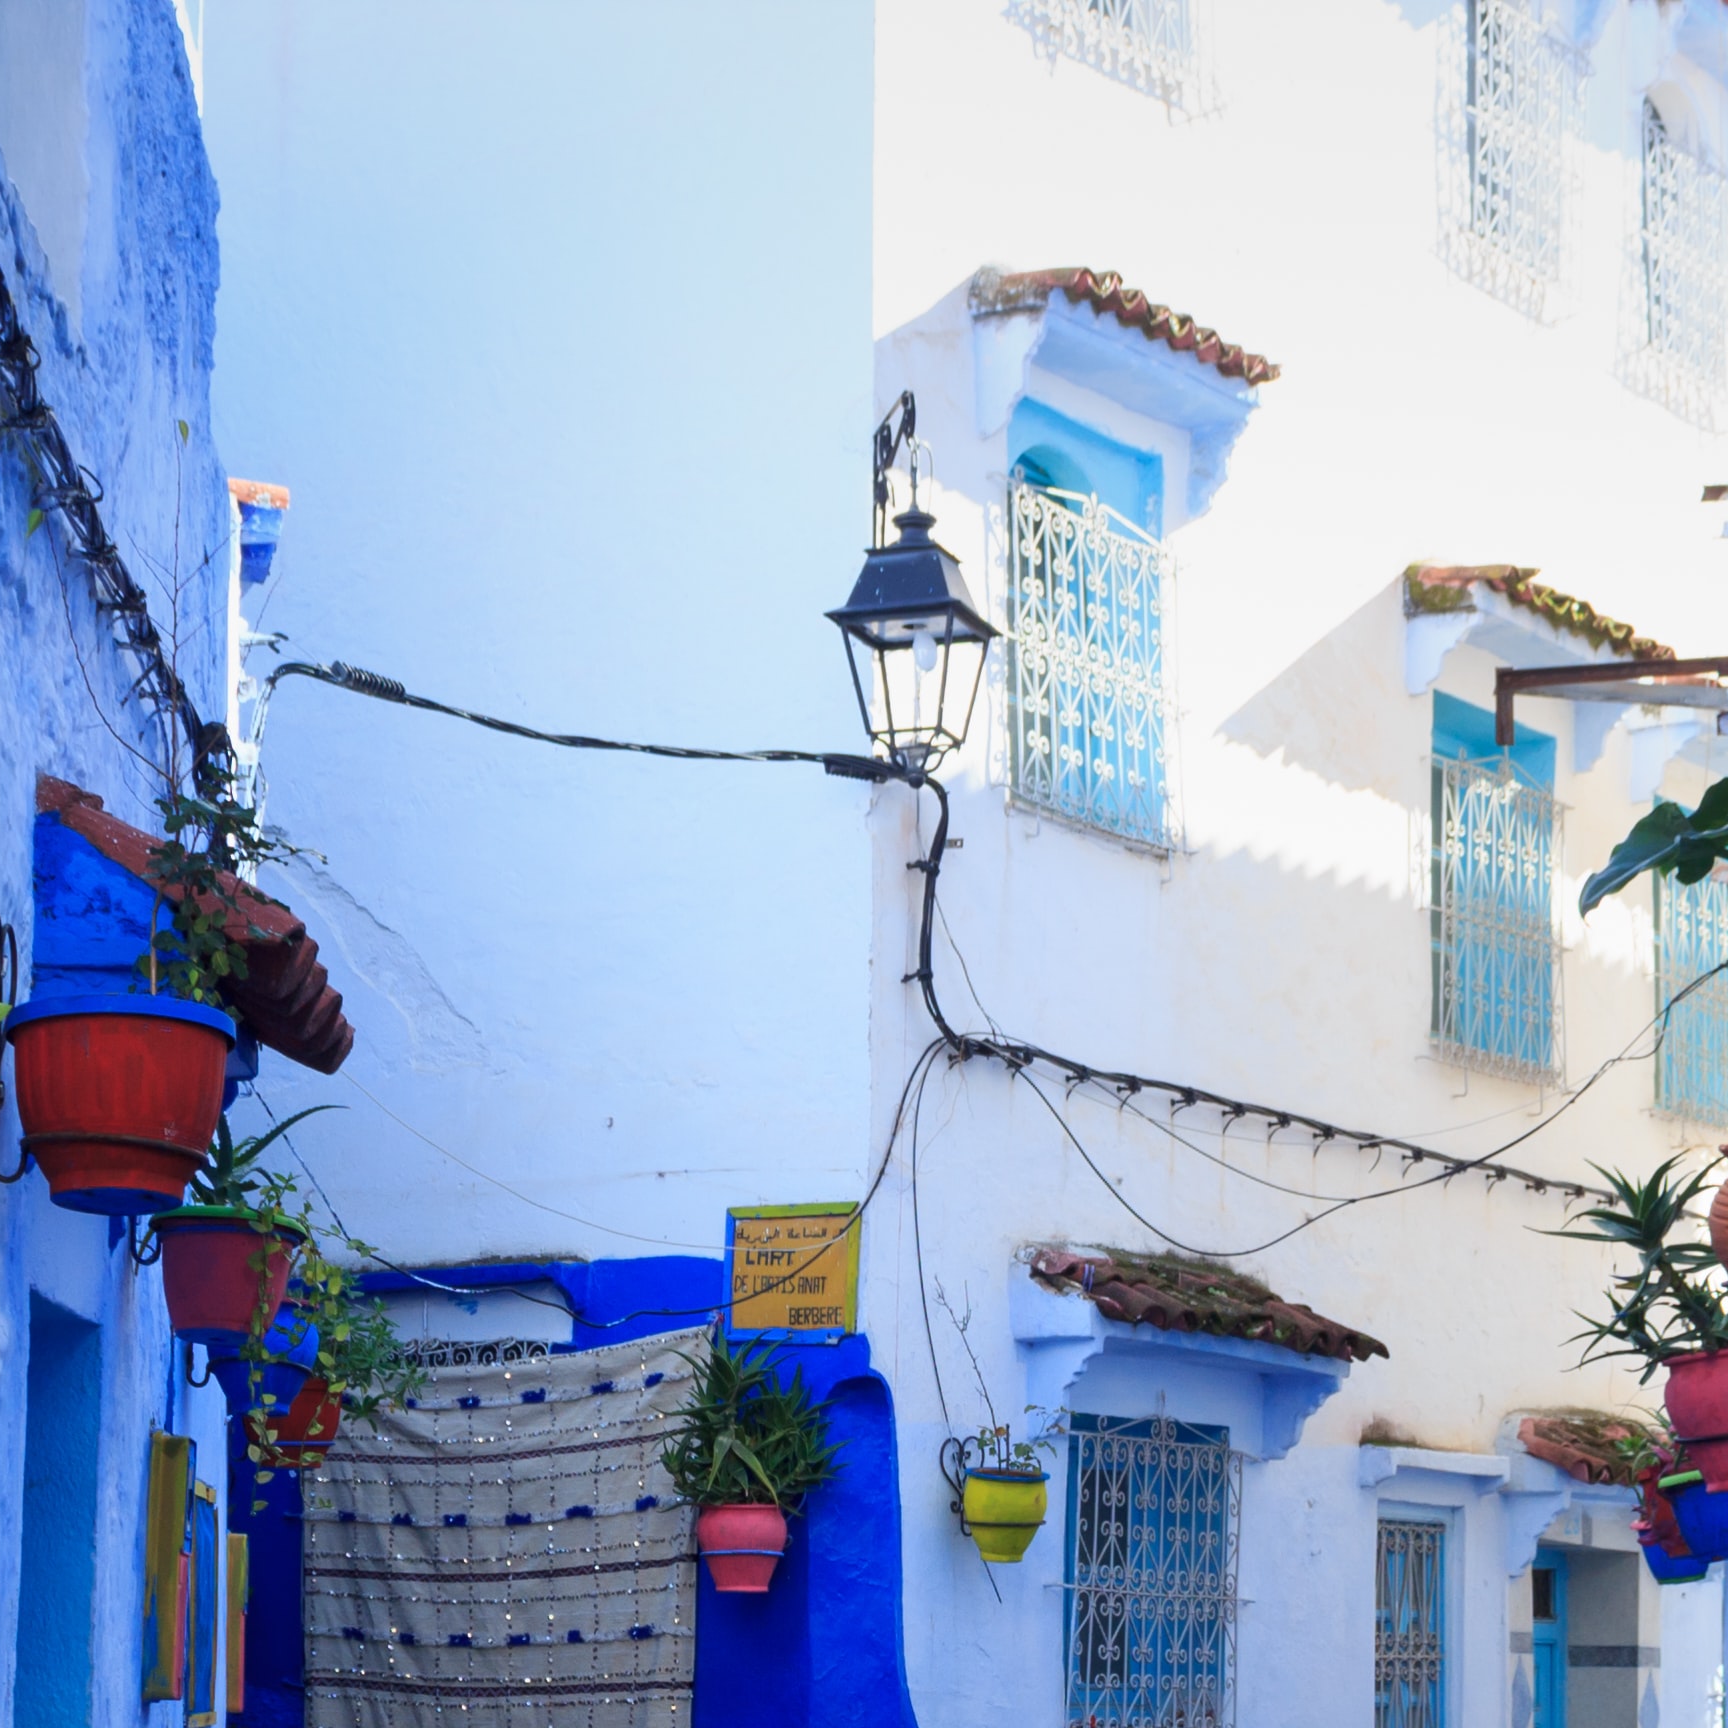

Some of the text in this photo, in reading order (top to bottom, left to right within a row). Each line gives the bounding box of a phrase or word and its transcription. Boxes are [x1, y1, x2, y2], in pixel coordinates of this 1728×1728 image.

[745, 1245, 796, 1266] L'ART
[733, 1274, 749, 1294] DE
[788, 1306, 843, 1326] BERBERE
